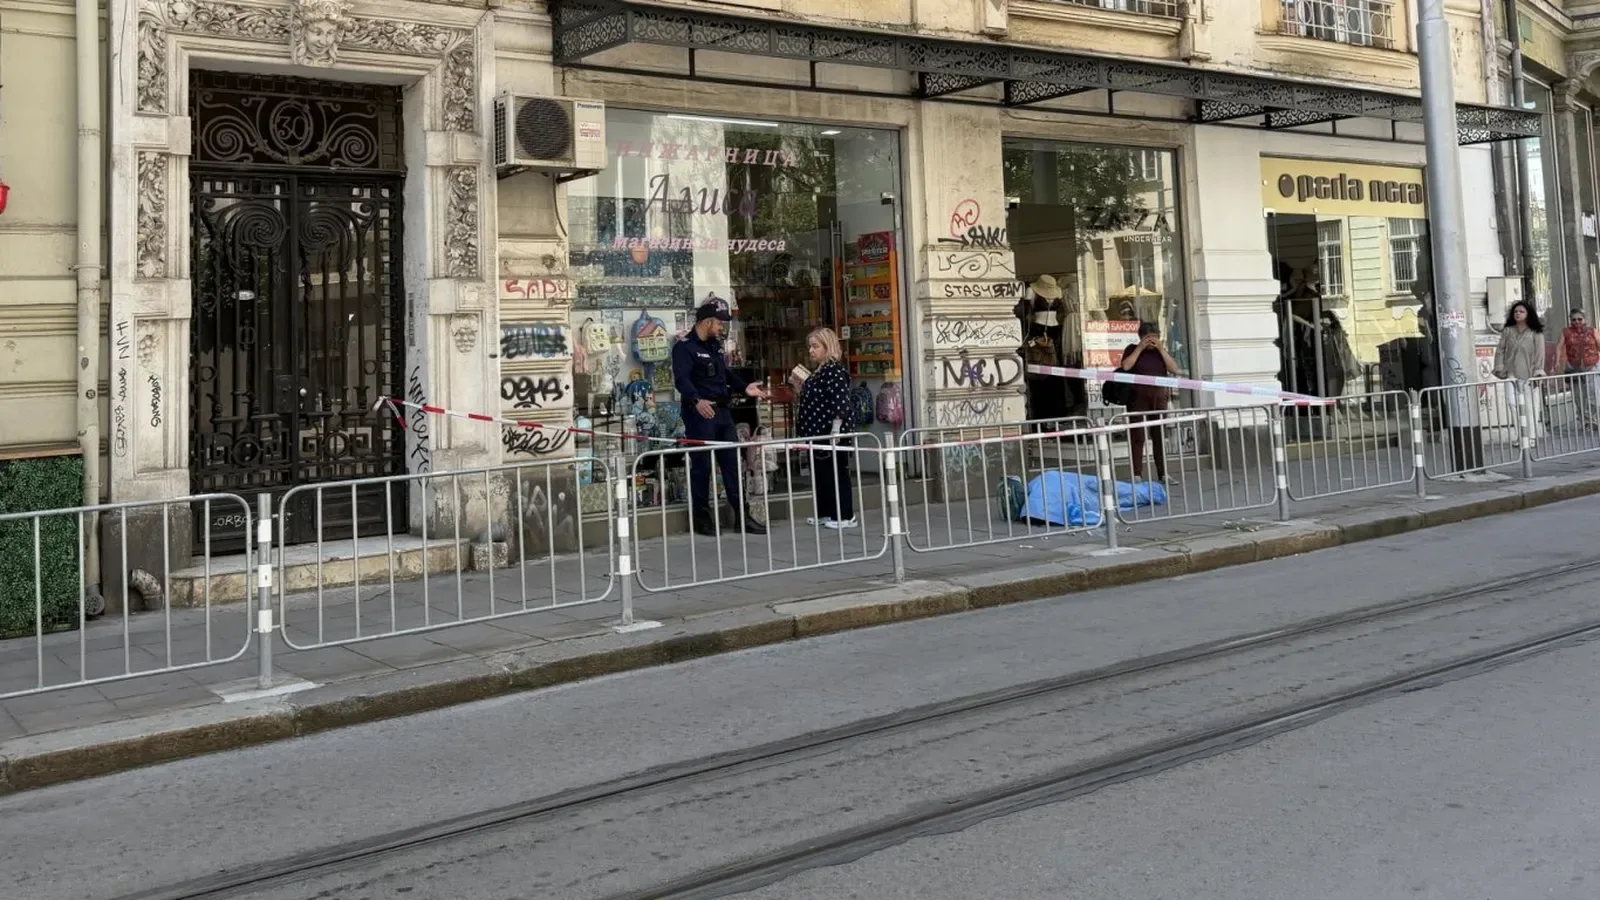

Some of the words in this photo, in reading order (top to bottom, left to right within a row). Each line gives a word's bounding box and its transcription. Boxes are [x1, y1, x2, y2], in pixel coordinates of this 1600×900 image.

[278, 115, 309, 140] 30
[614, 139, 799, 167] НИЖАРНИЦА
[635, 173, 759, 217] Алиса
[1369, 179, 1423, 204] nera
